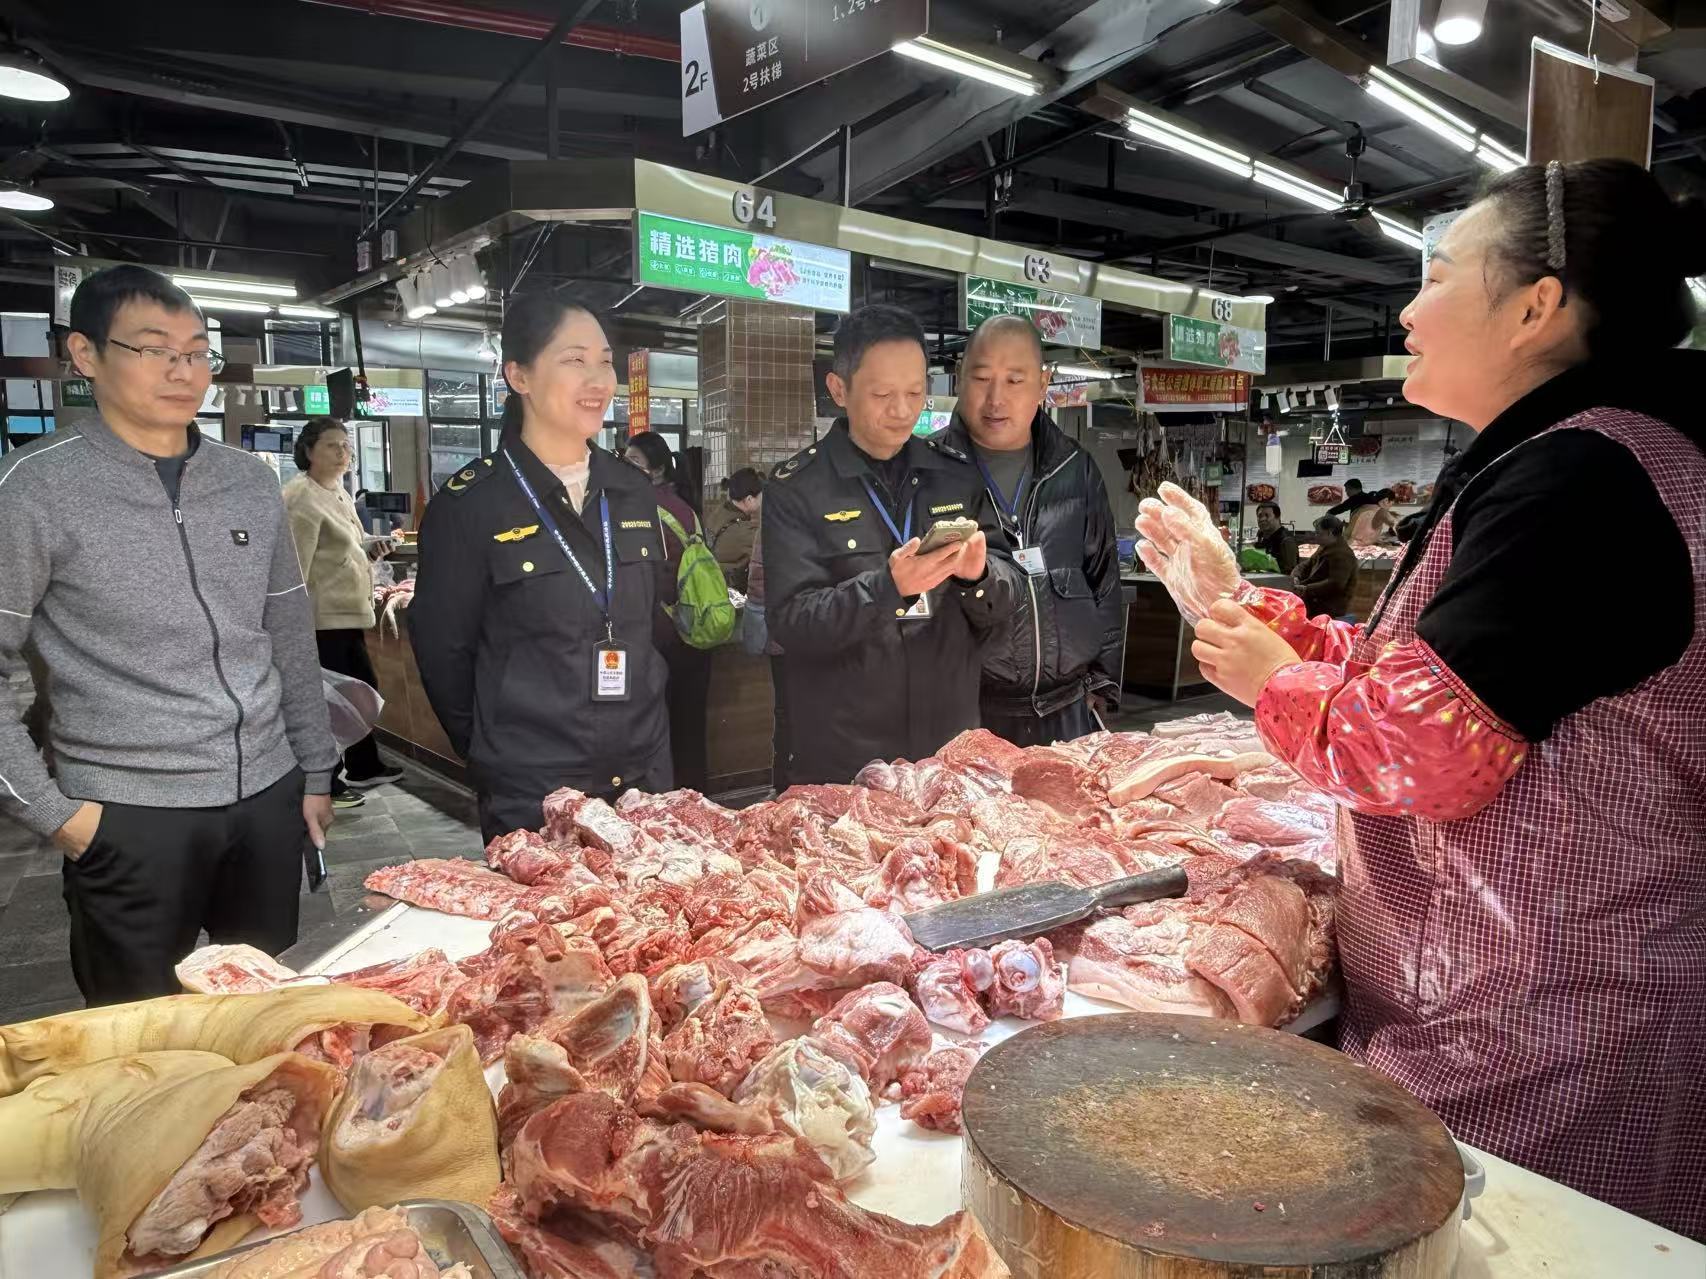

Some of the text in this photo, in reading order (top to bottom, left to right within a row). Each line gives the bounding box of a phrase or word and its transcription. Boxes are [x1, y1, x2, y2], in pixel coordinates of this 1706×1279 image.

[745, 36, 779, 67] 蔬菜区
[685, 60, 709, 98] 2F
[743, 61, 782, 93] 2号扶梯
[733, 190, 777, 228] 64
[649, 229, 742, 268] 精选猪肉
[1025, 255, 1052, 283] 63
[1212, 298, 1233, 321] 68
